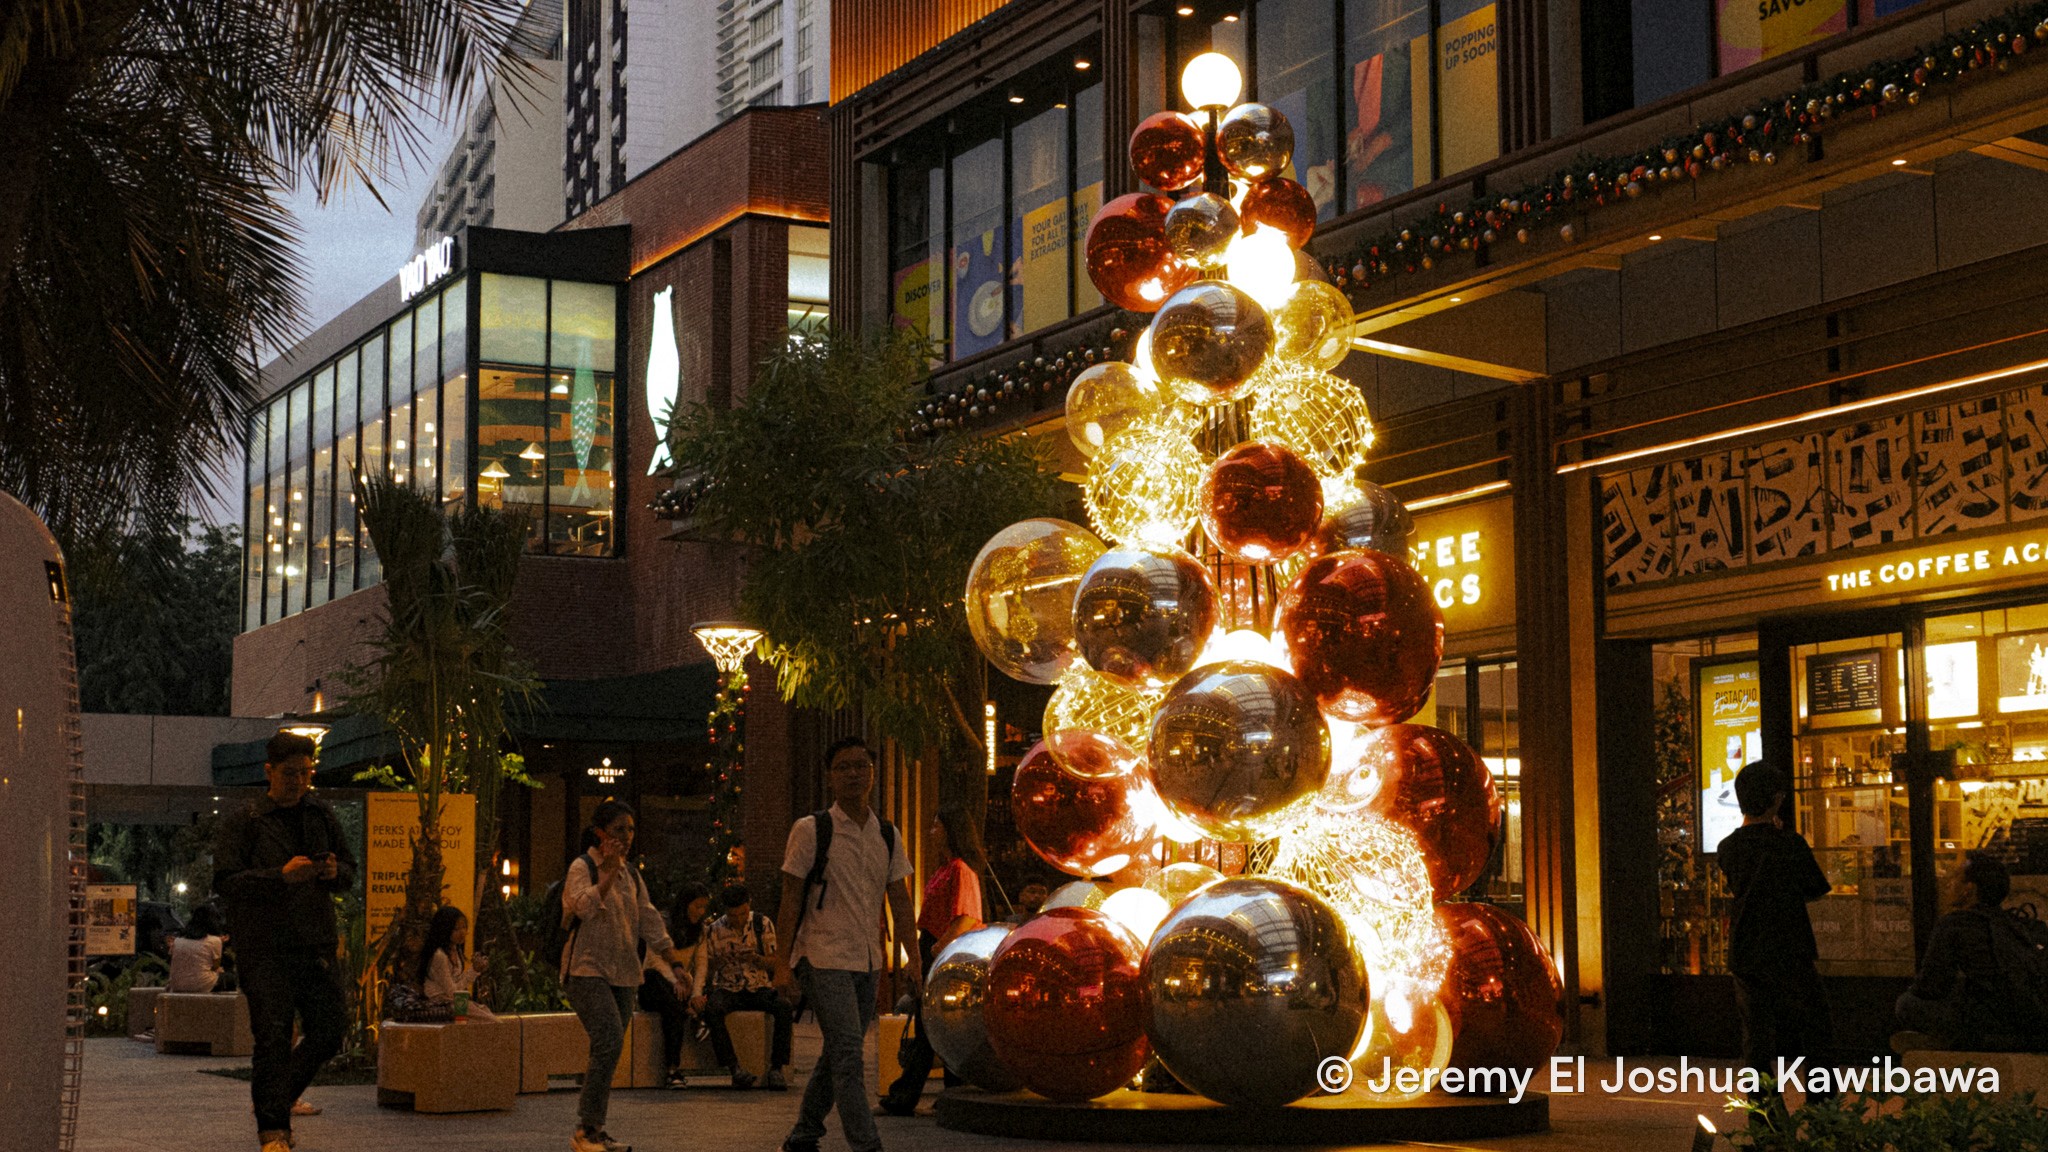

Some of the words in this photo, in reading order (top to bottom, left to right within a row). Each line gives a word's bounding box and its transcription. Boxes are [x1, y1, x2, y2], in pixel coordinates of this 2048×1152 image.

[1759, 0, 1806, 20] SAV
[1446, 24, 1494, 55] POPPING
[1446, 54, 1460, 70] UP
[1463, 39, 1495, 64] SOON
[1032, 218, 1051, 234] YOUR
[1031, 234, 1045, 247] FOR
[1047, 228, 1058, 240] ALL
[399, 254, 425, 302] YAO
[425, 236, 453, 285] YAO
[905, 279, 941, 304] DISCOVER
[1827, 569, 1872, 592] THE
[1879, 550, 1991, 583] COFFEE
[2002, 543, 2048, 566] AC
[1424, 574, 1480, 608] CS
[1715, 688, 1757, 704] PISTACHIO
[587, 768, 625, 776] OSTERIA
[373, 825, 405, 835] PERKS
[373, 839, 405, 848] MADE
[440, 840, 461, 848] OU!
[372, 871, 408, 881] TRIPLE
[372, 884, 406, 893] REWA
